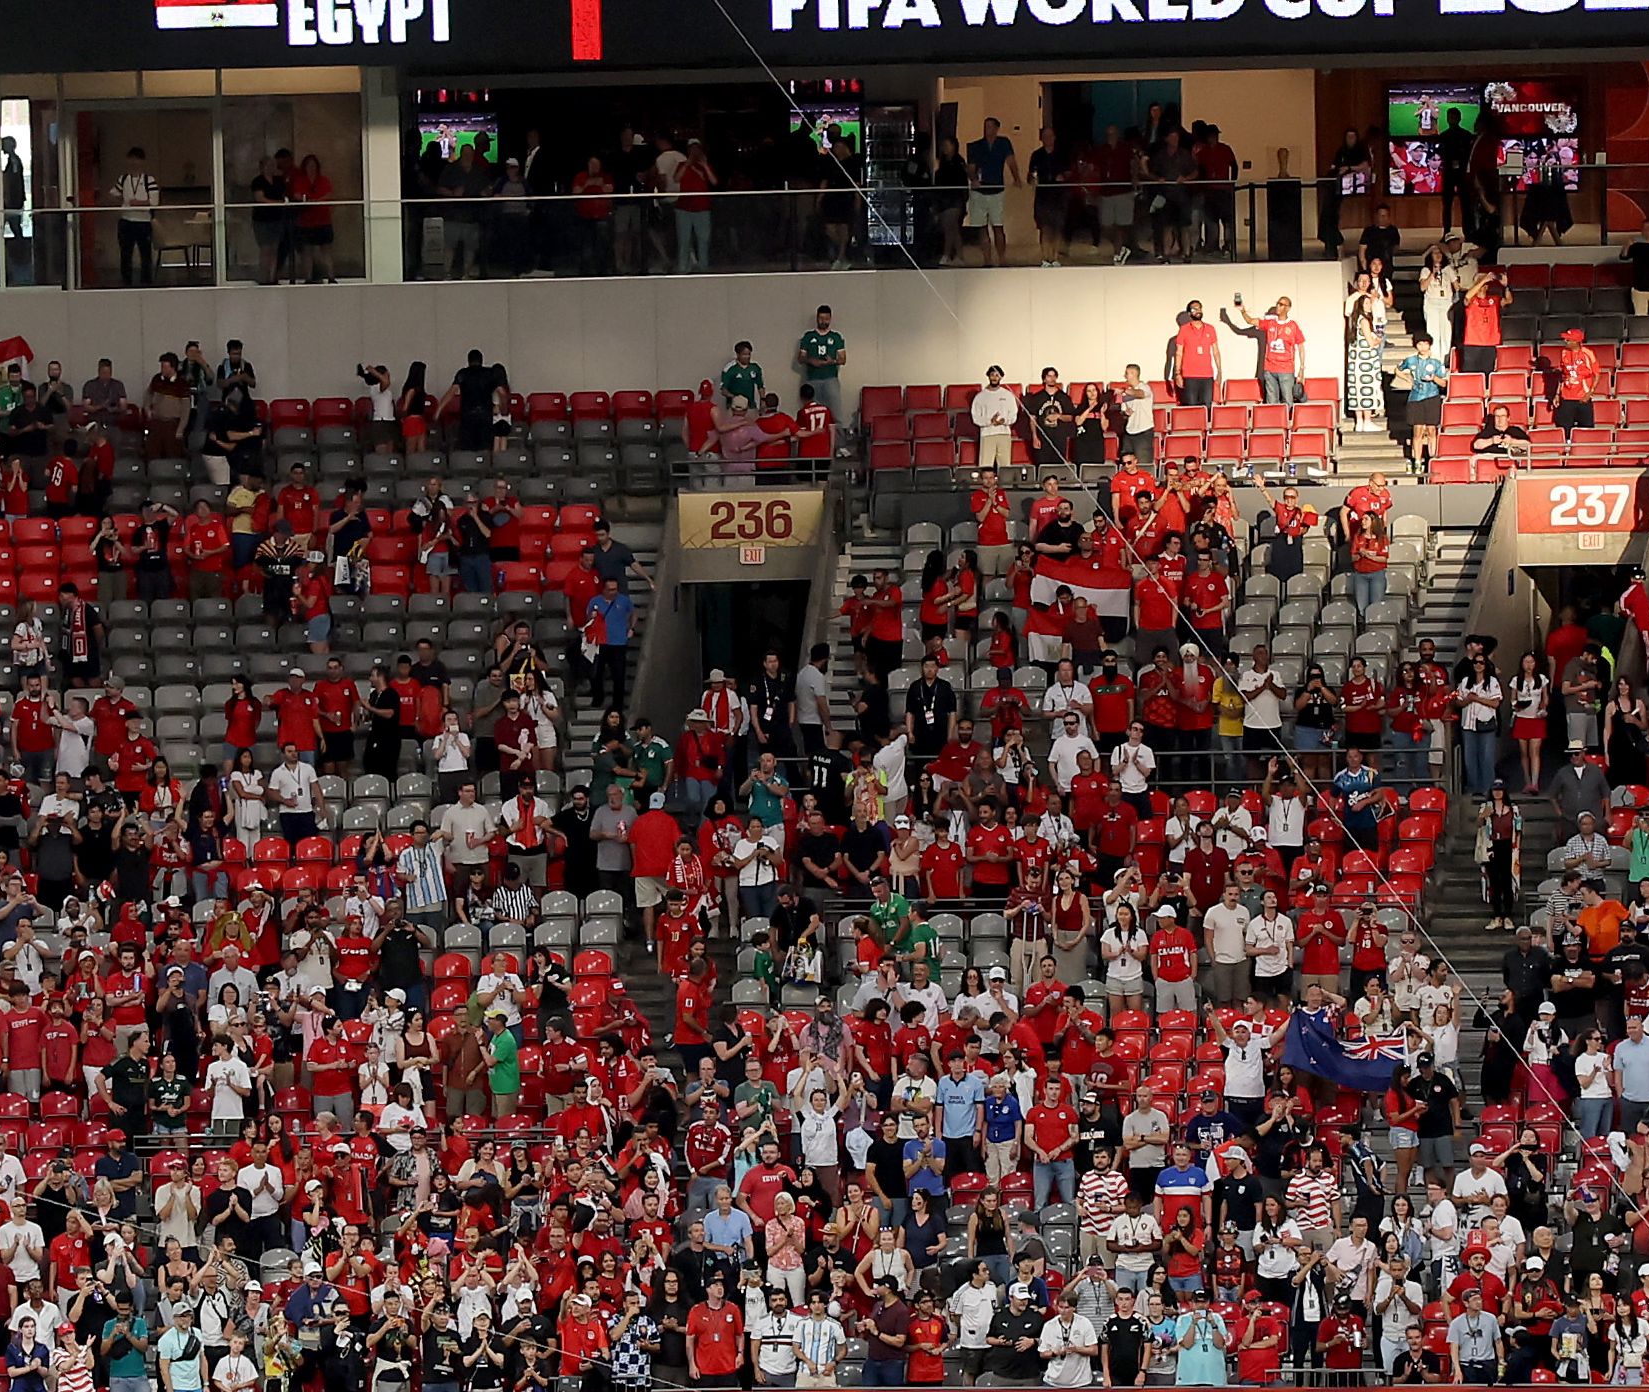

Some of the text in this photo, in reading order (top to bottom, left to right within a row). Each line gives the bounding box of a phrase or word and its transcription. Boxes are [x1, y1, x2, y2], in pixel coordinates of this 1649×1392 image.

[288, 0, 451, 46] EGYPT
[1495, 103, 1565, 114] VANCOUVER
[810, 412, 826, 431] 17
[51, 465, 64, 487] 19
[1549, 484, 1631, 526] 237
[709, 500, 792, 541] 236
[1582, 536, 1602, 550] EXIT
[743, 547, 764, 564] EXIT
[813, 766, 828, 788] 11
